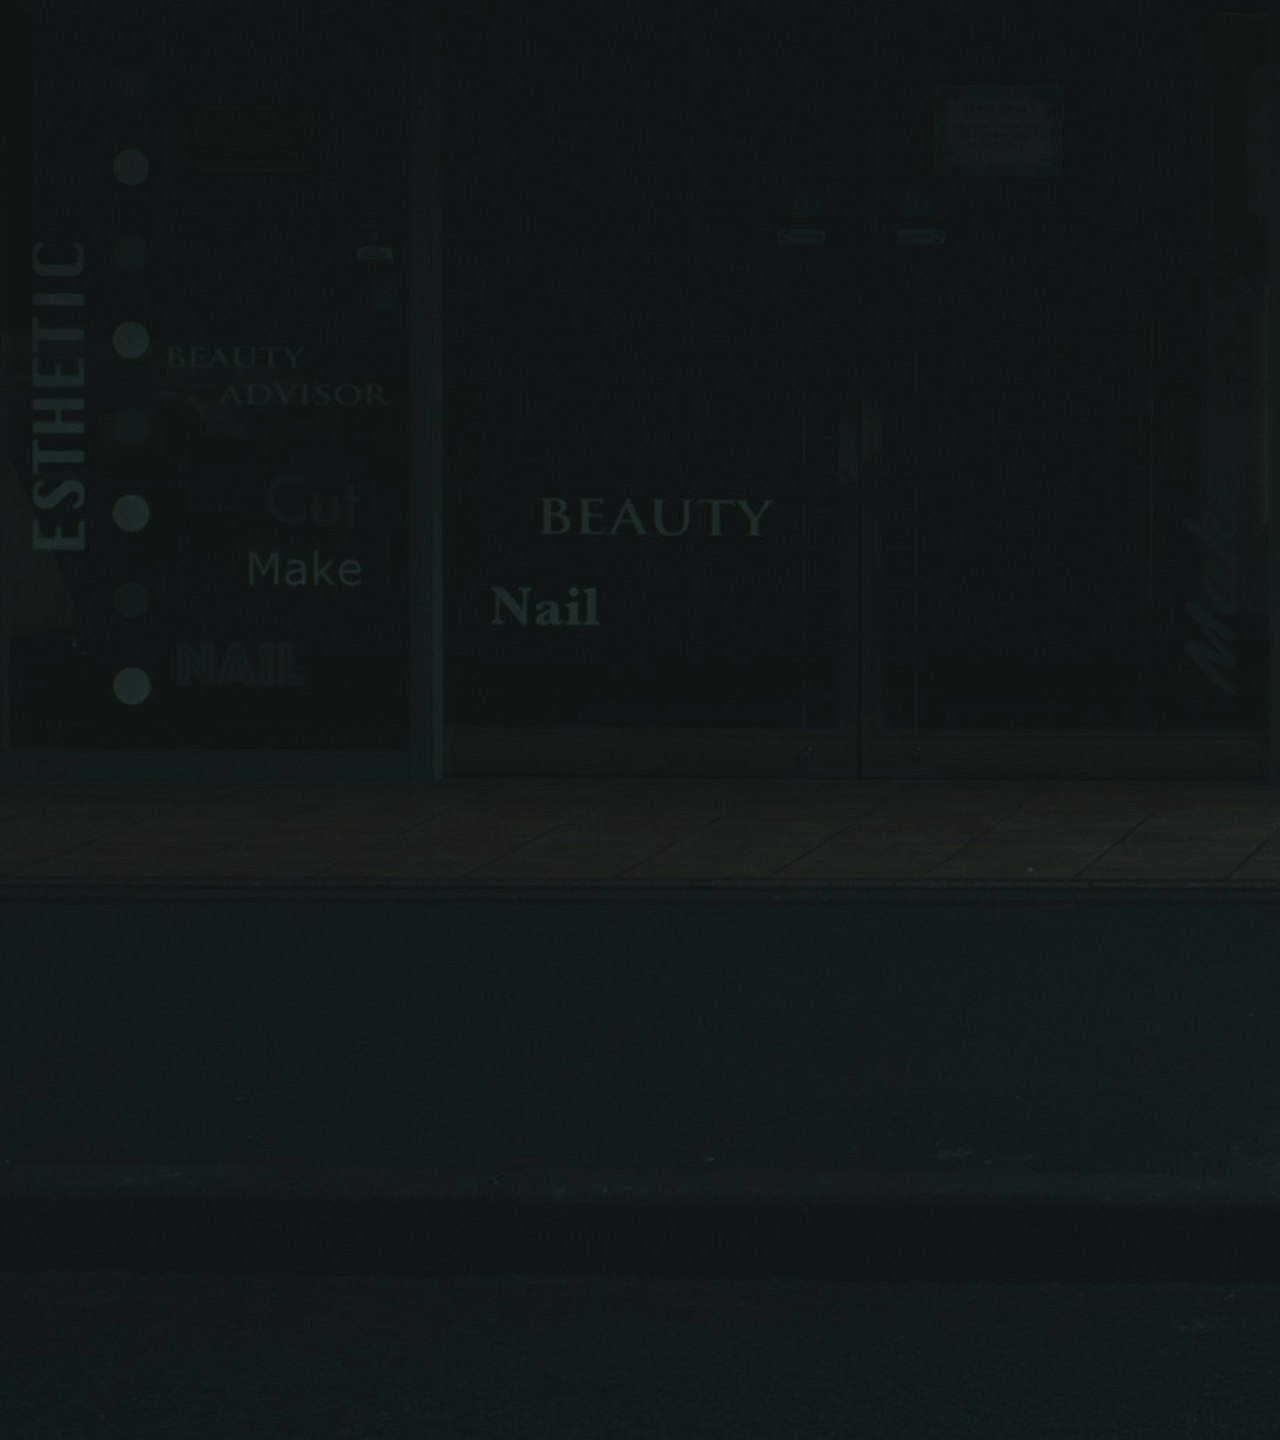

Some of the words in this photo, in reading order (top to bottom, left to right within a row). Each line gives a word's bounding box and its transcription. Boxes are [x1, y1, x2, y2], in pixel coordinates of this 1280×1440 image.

[166, 346, 304, 369] BEAUTY
[32, 239, 86, 552] ESTHETIC
[219, 382, 388, 406] ADVISOR
[265, 472, 361, 528] Cut
[540, 494, 775, 539] BEAUTY
[247, 550, 363, 587] Make
[490, 584, 600, 628] Nail
[175, 639, 307, 689] NAIL
